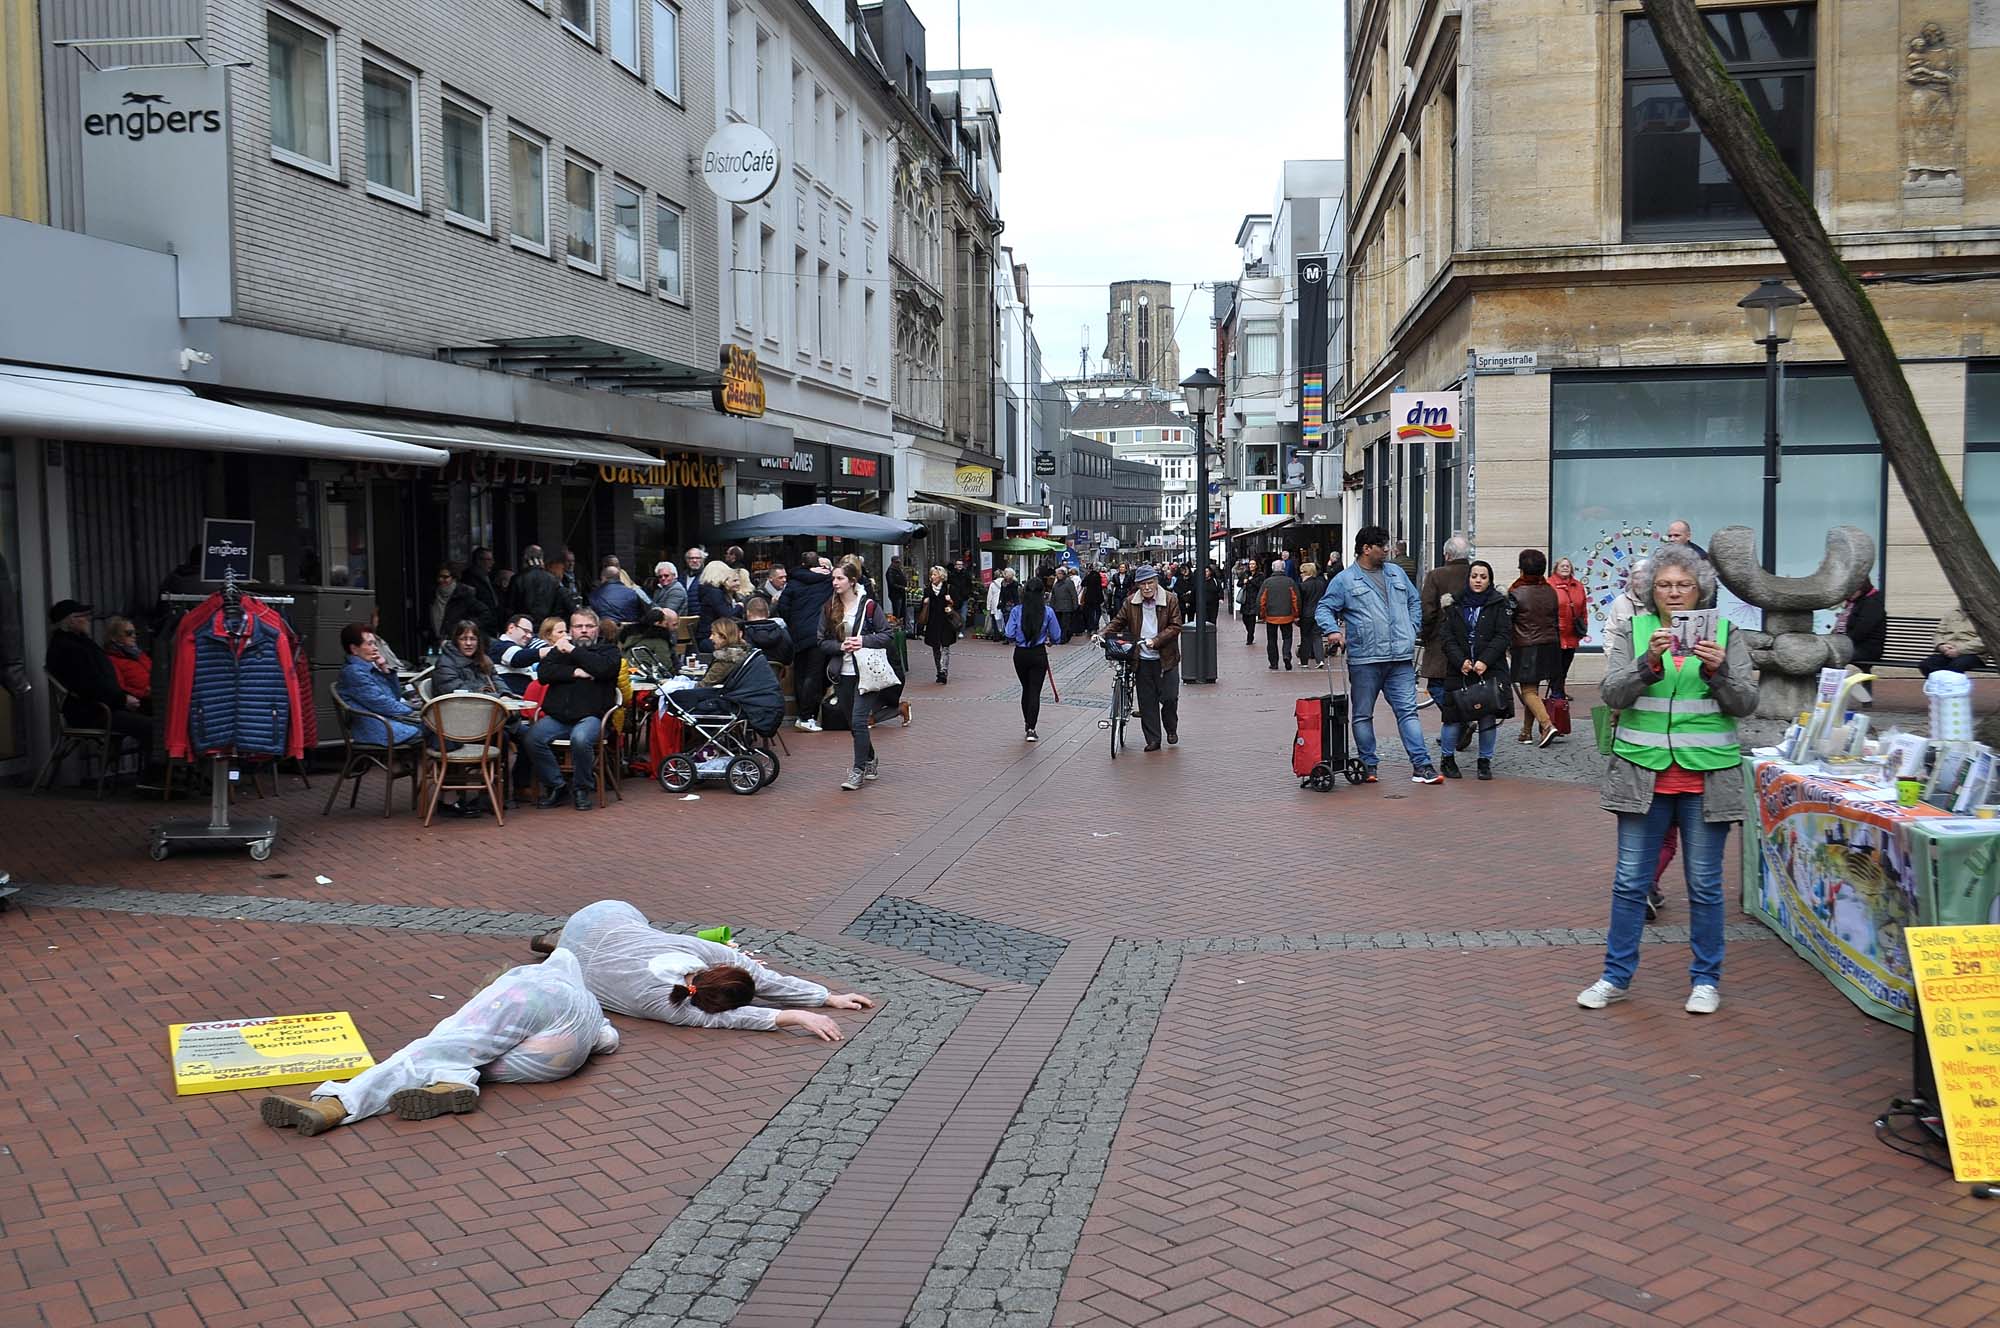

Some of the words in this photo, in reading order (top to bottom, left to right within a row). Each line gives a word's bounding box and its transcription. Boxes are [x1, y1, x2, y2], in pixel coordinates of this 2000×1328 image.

[84, 104, 221, 141] engbers
[704, 148, 774, 173] BistroCafé
[1478, 355, 1534, 367] Springestraße
[1406, 400, 1448, 425] dm
[208, 544, 248, 557] engbers
[1969, 1094, 1998, 1108] Was
